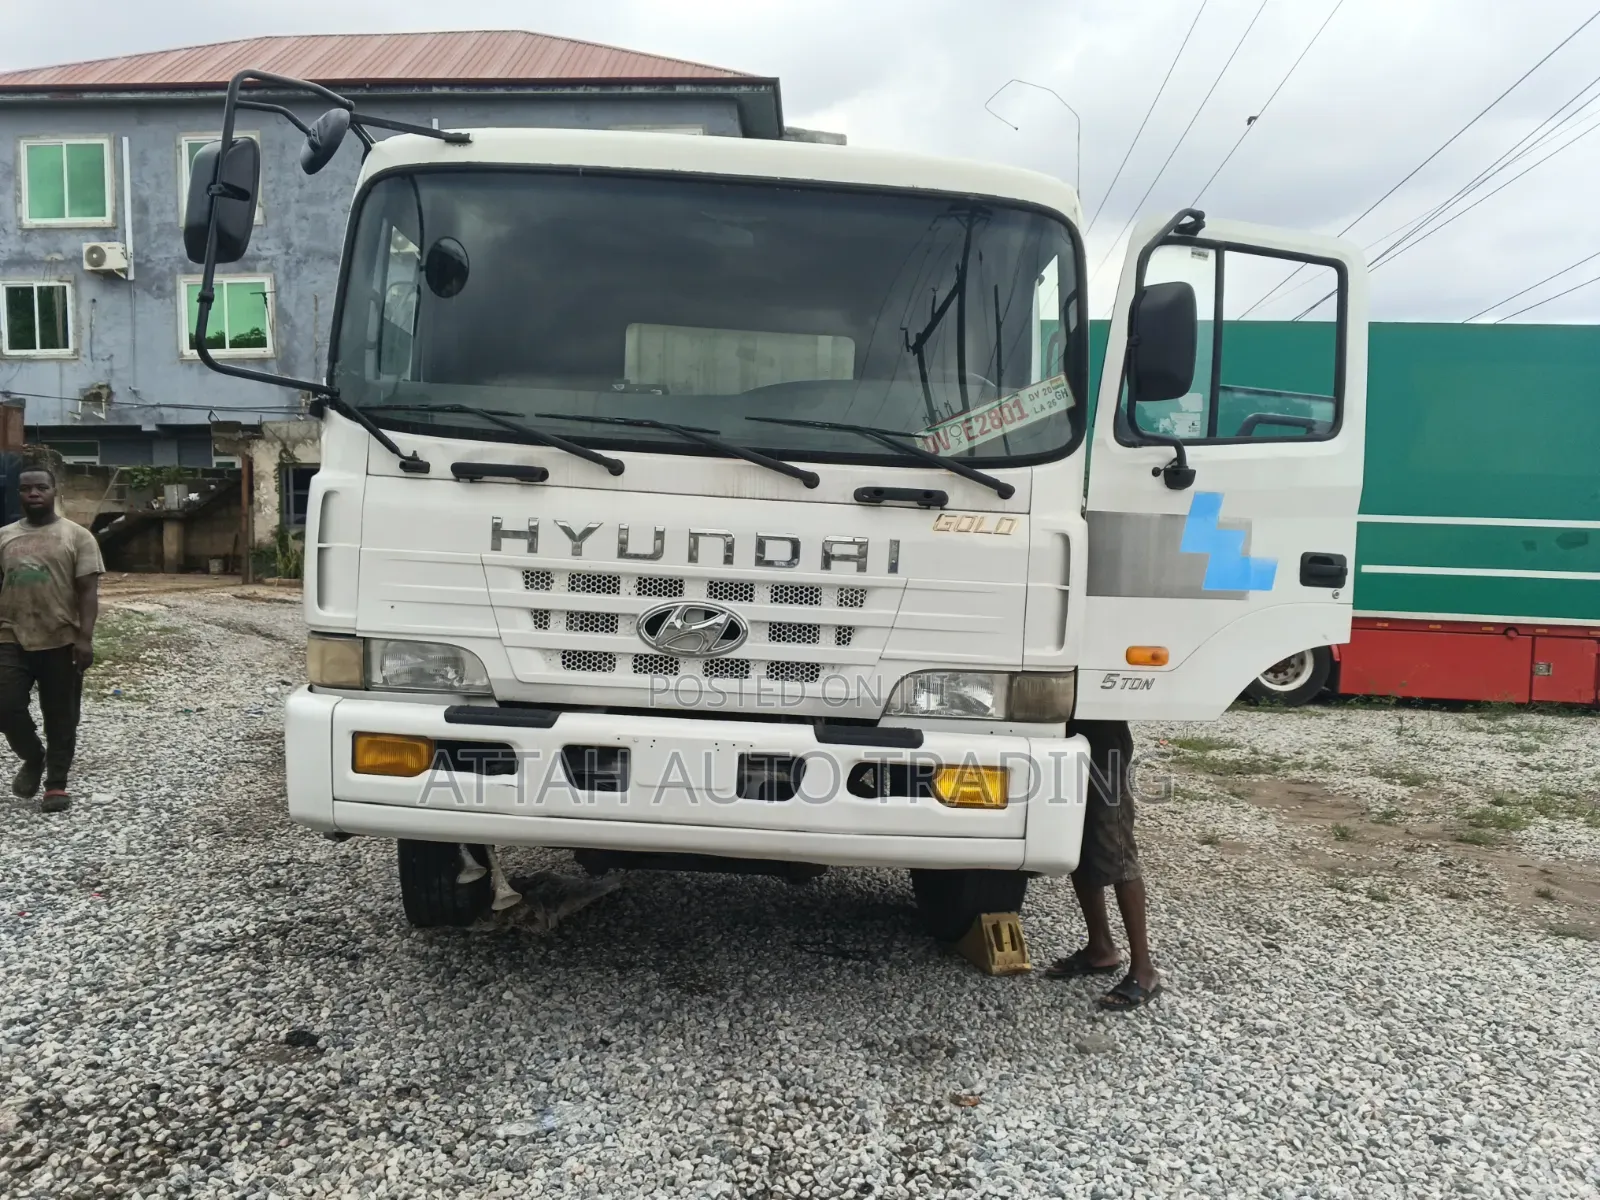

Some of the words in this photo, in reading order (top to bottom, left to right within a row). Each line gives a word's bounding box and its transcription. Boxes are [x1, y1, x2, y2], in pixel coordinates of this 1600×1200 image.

[1054, 388, 1069, 400] GH
[1033, 404, 1046, 414] LA
[933, 514, 1017, 535] GOLD
[490, 516, 901, 574] HYUNDAI
[1100, 673, 1120, 689] 5
[1120, 678, 1155, 690] TON
